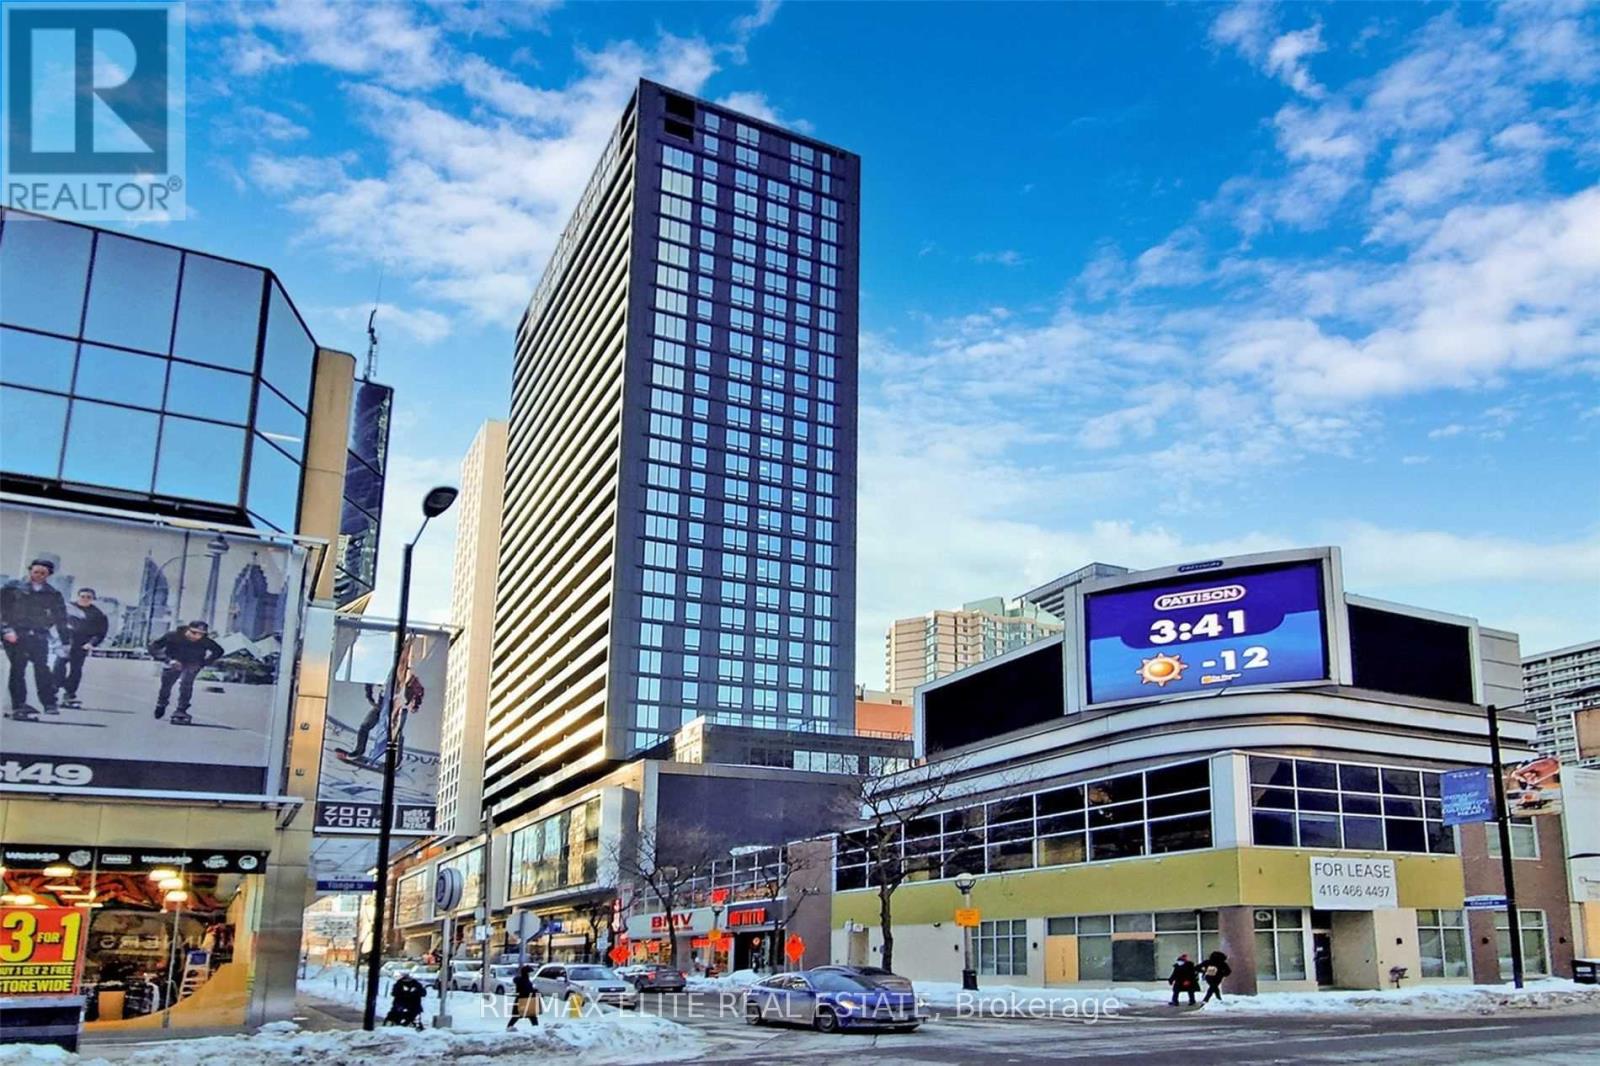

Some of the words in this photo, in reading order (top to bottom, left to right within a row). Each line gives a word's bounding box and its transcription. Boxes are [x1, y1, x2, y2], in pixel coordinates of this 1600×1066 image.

[1160, 587, 1239, 608] PATTISON
[1149, 610, 1246, 645] 3:41
[1202, 646, 1270, 672] -12
[0, 761, 93, 786] t49
[324, 806, 372, 817] ZOO
[1314, 862, 1344, 877] FOR
[1347, 863, 1392, 879] LEASE
[1319, 884, 1340, 897] 416
[651, 912, 694, 929] BMV
[0, 911, 36, 962] 3
[37, 931, 60, 943] FOR
[60, 911, 80, 961] 1
[22, 966, 40, 975] GET
[50, 966, 73, 975] FREE
